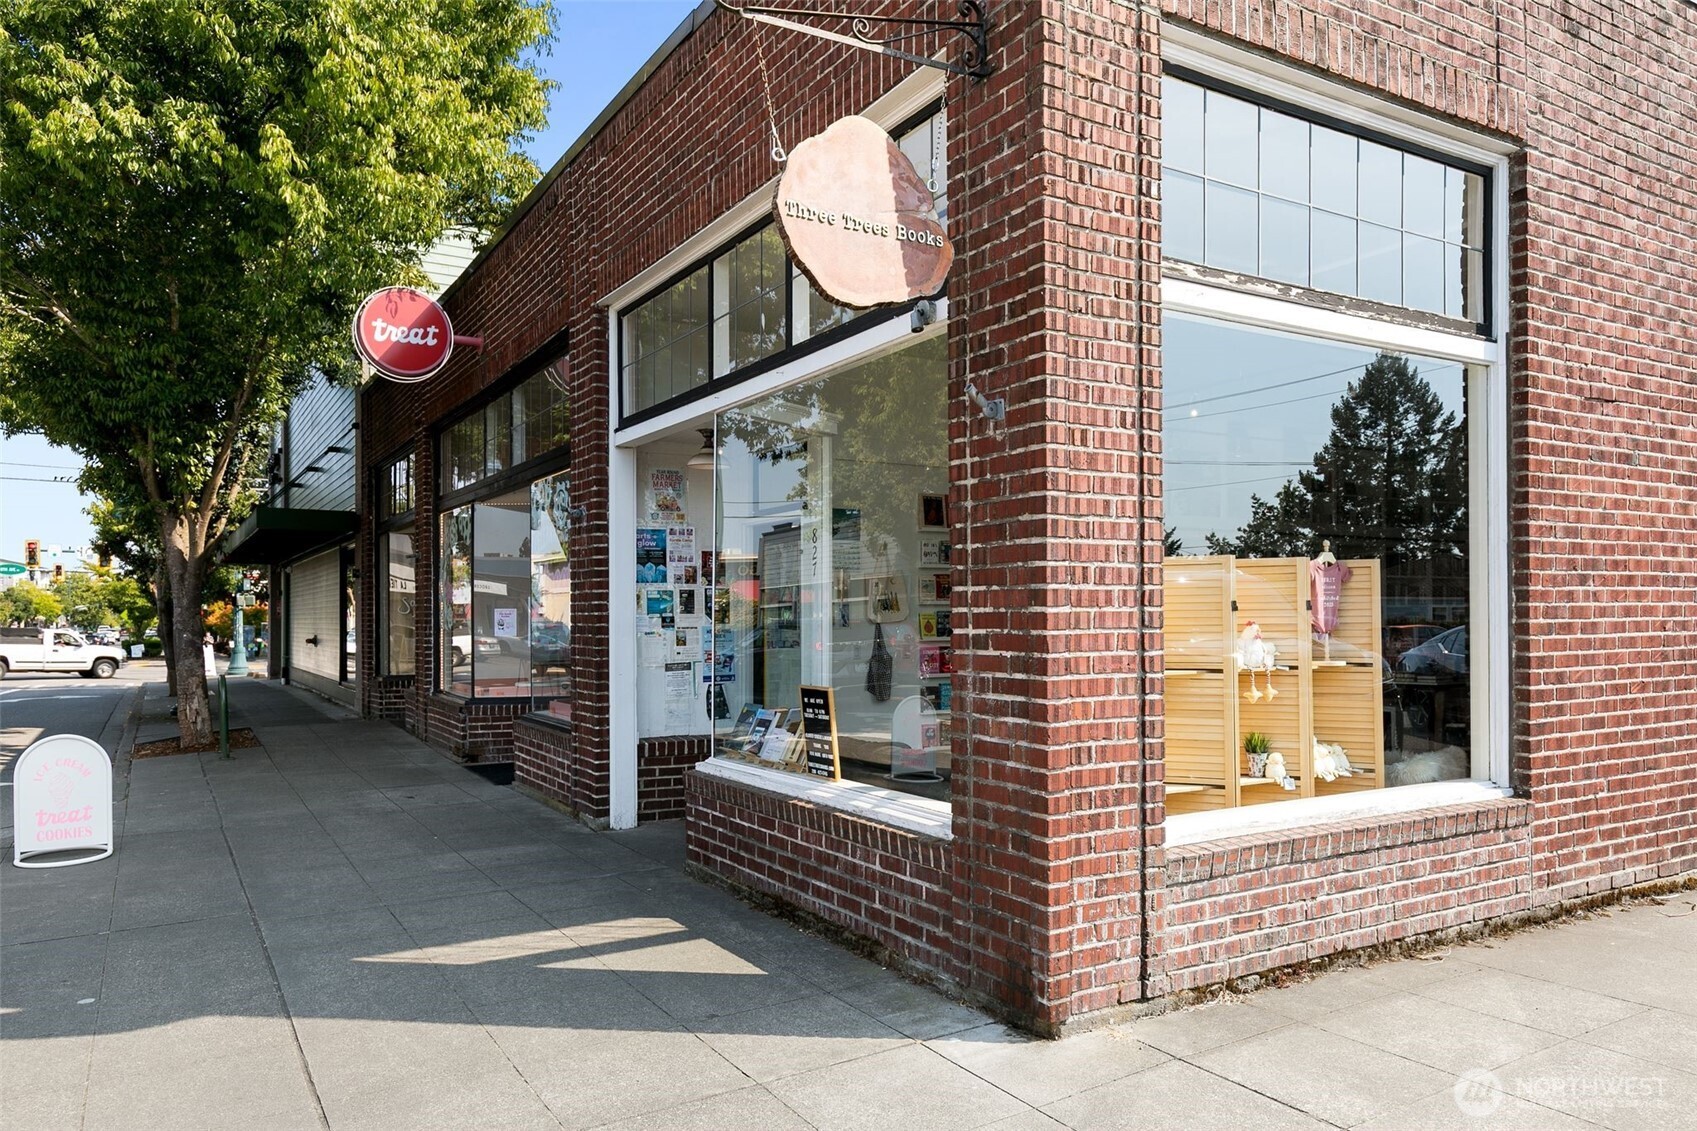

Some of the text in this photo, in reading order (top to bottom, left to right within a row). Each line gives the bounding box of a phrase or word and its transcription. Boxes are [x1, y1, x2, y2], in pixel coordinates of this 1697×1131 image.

[785, 199, 944, 248] Three Trees Books
[371, 318, 439, 346] treat
[652, 474, 683, 482] FARMERS
[652, 481, 682, 489] MARKET
[637, 539, 656, 548] glow
[35, 804, 94, 827] treat
[36, 826, 92, 842] COOKIES
